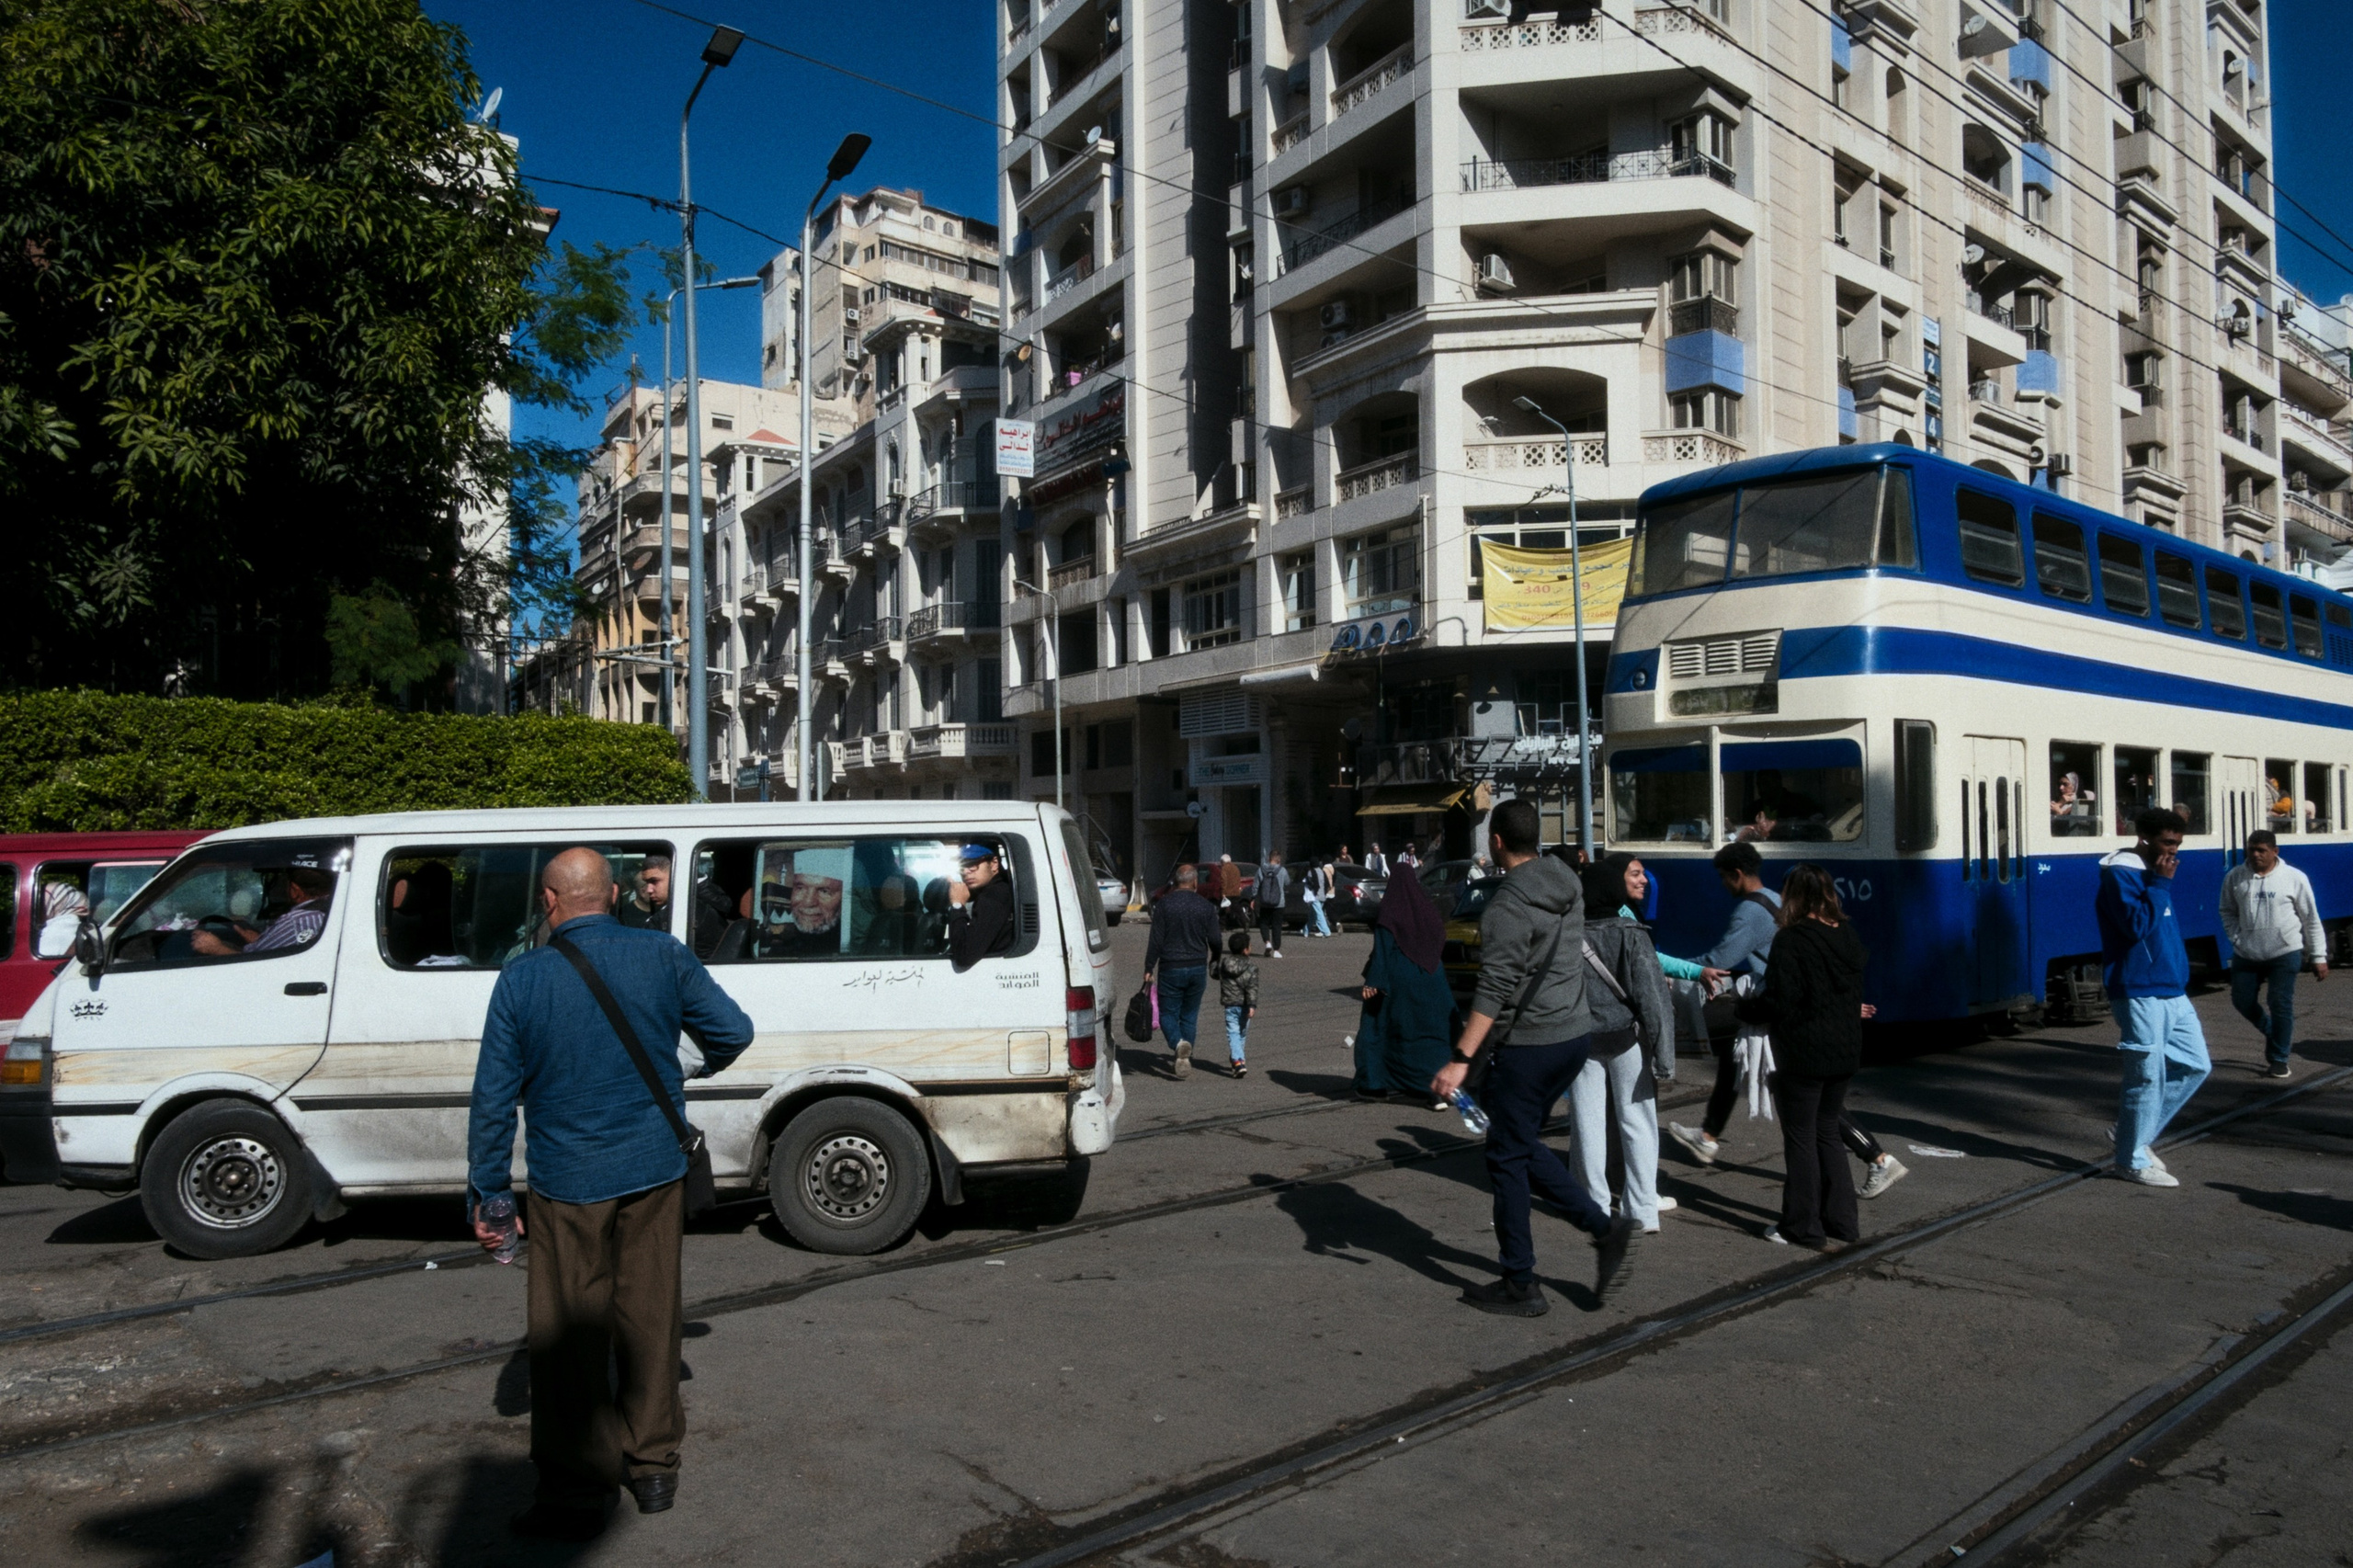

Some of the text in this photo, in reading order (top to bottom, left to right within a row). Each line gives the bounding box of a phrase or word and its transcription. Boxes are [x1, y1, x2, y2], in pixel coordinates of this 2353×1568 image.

[999, 427, 1031, 441] ابراهيم
[1548, 565, 1574, 575] كاتب
[1524, 585, 1551, 594] 340
[1561, 734, 1580, 751] لبن
